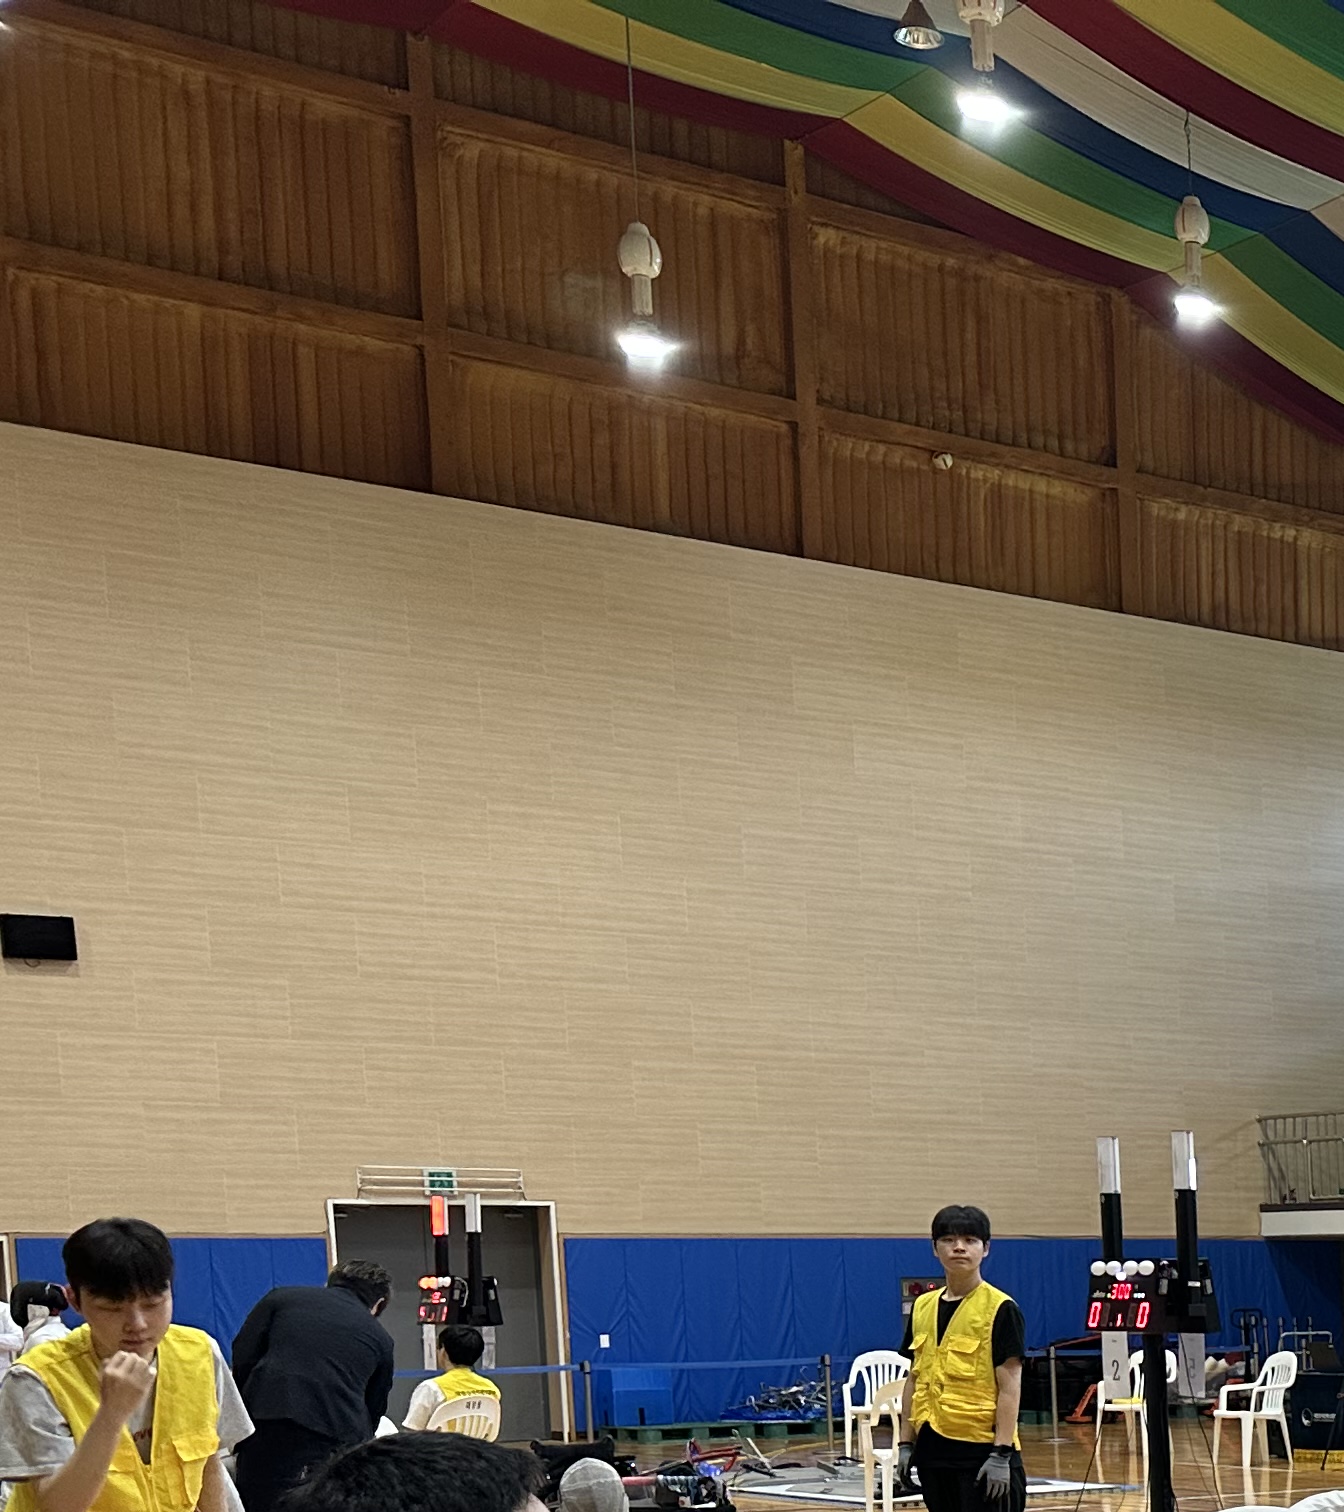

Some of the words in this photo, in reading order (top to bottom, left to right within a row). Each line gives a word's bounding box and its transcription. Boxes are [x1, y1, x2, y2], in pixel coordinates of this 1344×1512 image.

[1087, 1301, 1102, 1328] 0
[1135, 1301, 1150, 1328] 0
[1111, 1359, 1121, 1381] 2
